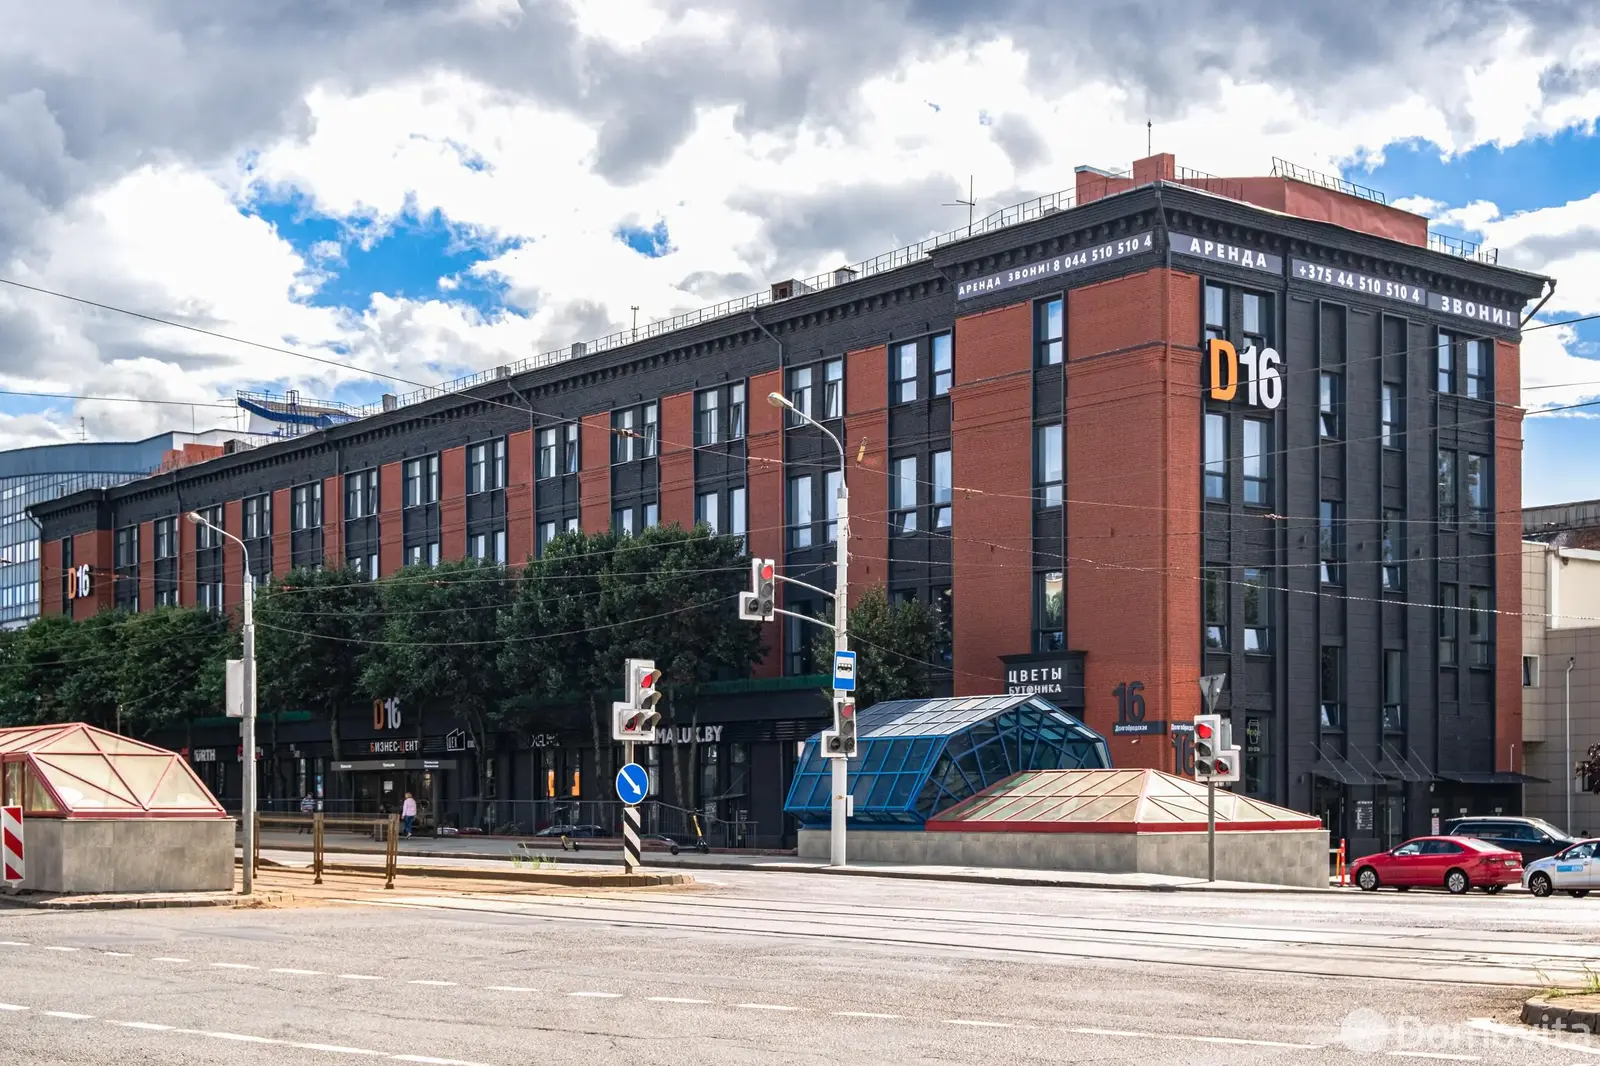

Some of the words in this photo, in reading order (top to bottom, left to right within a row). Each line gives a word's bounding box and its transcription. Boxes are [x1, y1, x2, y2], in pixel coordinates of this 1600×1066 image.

[958, 277, 1001, 296] АРЕНДА
[1008, 261, 1050, 282] ЗВОНИ!
[1053, 260, 1060, 272] 8
[1064, 254, 1087, 269] 044
[1092, 246, 1113, 261] 510
[1117, 240, 1139, 255] 510
[1143, 237, 1152, 247] 4
[1190, 237, 1267, 268] АРЕНДА
[1299, 264, 1332, 283] +375
[1337, 272, 1354, 288] 44
[1359, 276, 1381, 294] 510
[1386, 282, 1407, 300] 510
[1412, 289, 1420, 303] 4
[1441, 296, 1511, 327] ЗВОНИ!
[1208, 338, 1283, 410] D16
[68, 563, 91, 600] D16
[1009, 667, 1062, 684] ЦВЕТЫ
[1009, 684, 1062, 695] БУТОНИКА
[373, 697, 402, 730] D16
[1113, 681, 1146, 723] 16
[370, 740, 419, 753] БИЗНЕС-ЦЕНТ
